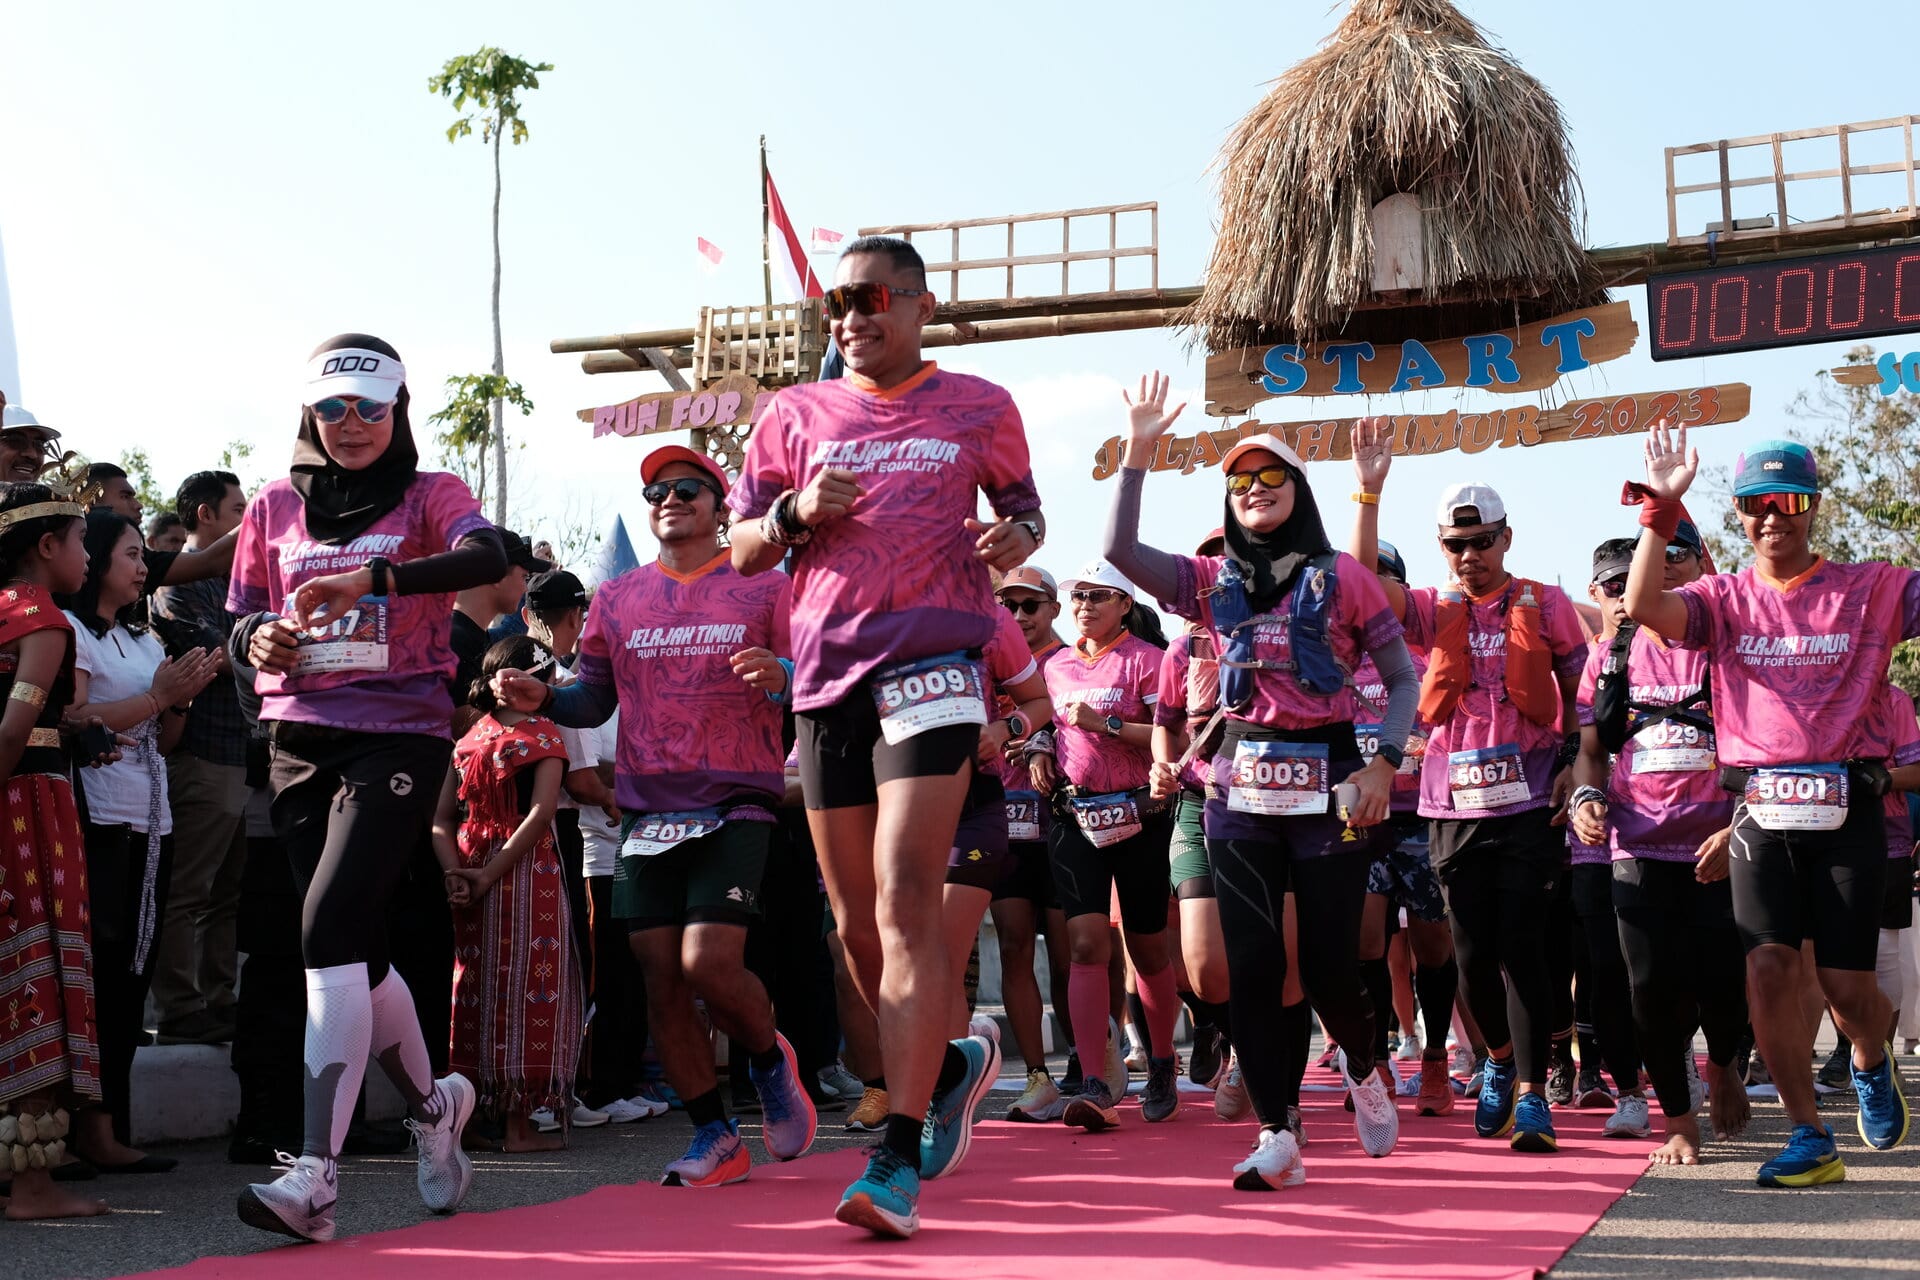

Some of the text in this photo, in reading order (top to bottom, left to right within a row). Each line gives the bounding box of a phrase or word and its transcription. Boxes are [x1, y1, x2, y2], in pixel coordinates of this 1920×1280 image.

[1262, 318, 1596, 394] START
[593, 399, 660, 438] RUN
[670, 391, 742, 430] FOR
[1092, 418, 1338, 480] JLAH
[1569, 386, 1720, 439] 2023
[896, 437, 960, 464] TIMUR
[878, 461, 943, 474] EQUALITY
[284, 561, 303, 575] RUN
[305, 559, 328, 571] FOR
[626, 624, 747, 650] JELAJAH TIMUR
[1799, 633, 1851, 655] TIMUR
[637, 644, 733, 659] RUN FOR EQUALITY
[1764, 657, 1784, 667] FOR
[1787, 654, 1840, 666] EQUALITY
[882, 668, 966, 708] 5009
[1356, 737, 1379, 754] 50
[1240, 761, 1309, 786] 5003
[1457, 761, 1508, 786] 5067
[1758, 776, 1827, 800] 5001
[1005, 803, 1027, 820] 37
[1079, 807, 1126, 831] 5032
